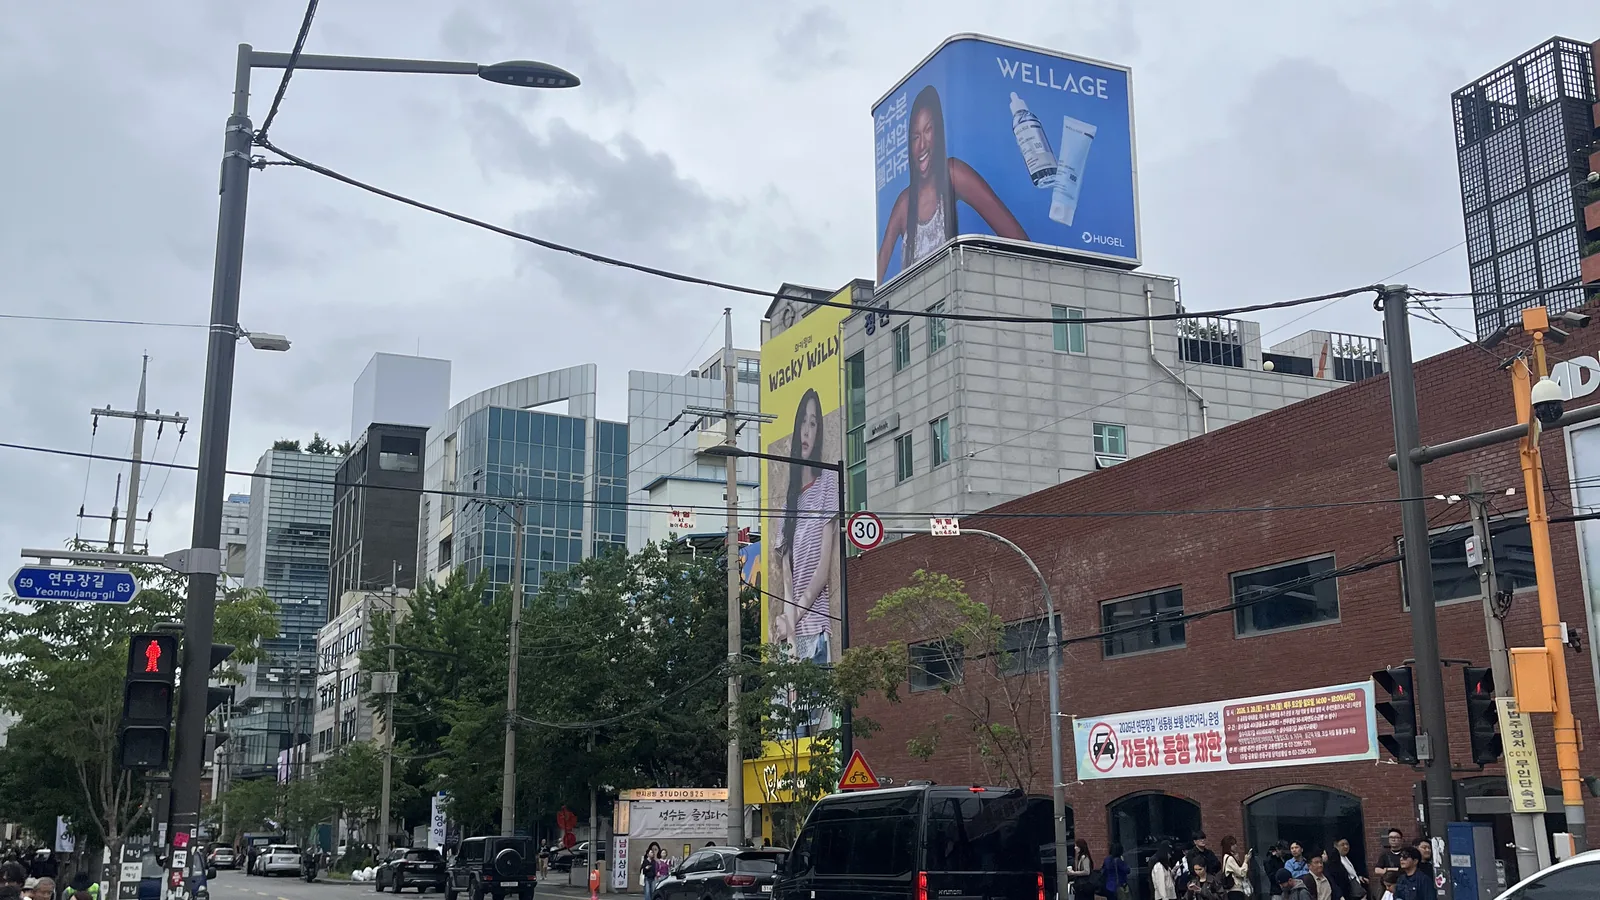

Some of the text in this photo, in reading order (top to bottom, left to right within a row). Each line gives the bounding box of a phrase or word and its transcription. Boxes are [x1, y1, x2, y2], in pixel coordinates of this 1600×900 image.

[996, 57, 1109, 100] WELLAGE
[876, 91, 907, 134] 속수분
[876, 119, 907, 165] 텐션업
[1093, 234, 1125, 248] HUGEL
[854, 521, 877, 539] 30
[19, 578, 34, 588] 59
[48, 572, 105, 589] 연무장길
[117, 583, 130, 593] 63
[34, 587, 115, 600] Yeonmujang-gil
[1208, 711, 1220, 726] 운영
[1121, 729, 1222, 768] 자동차 통행 제한
